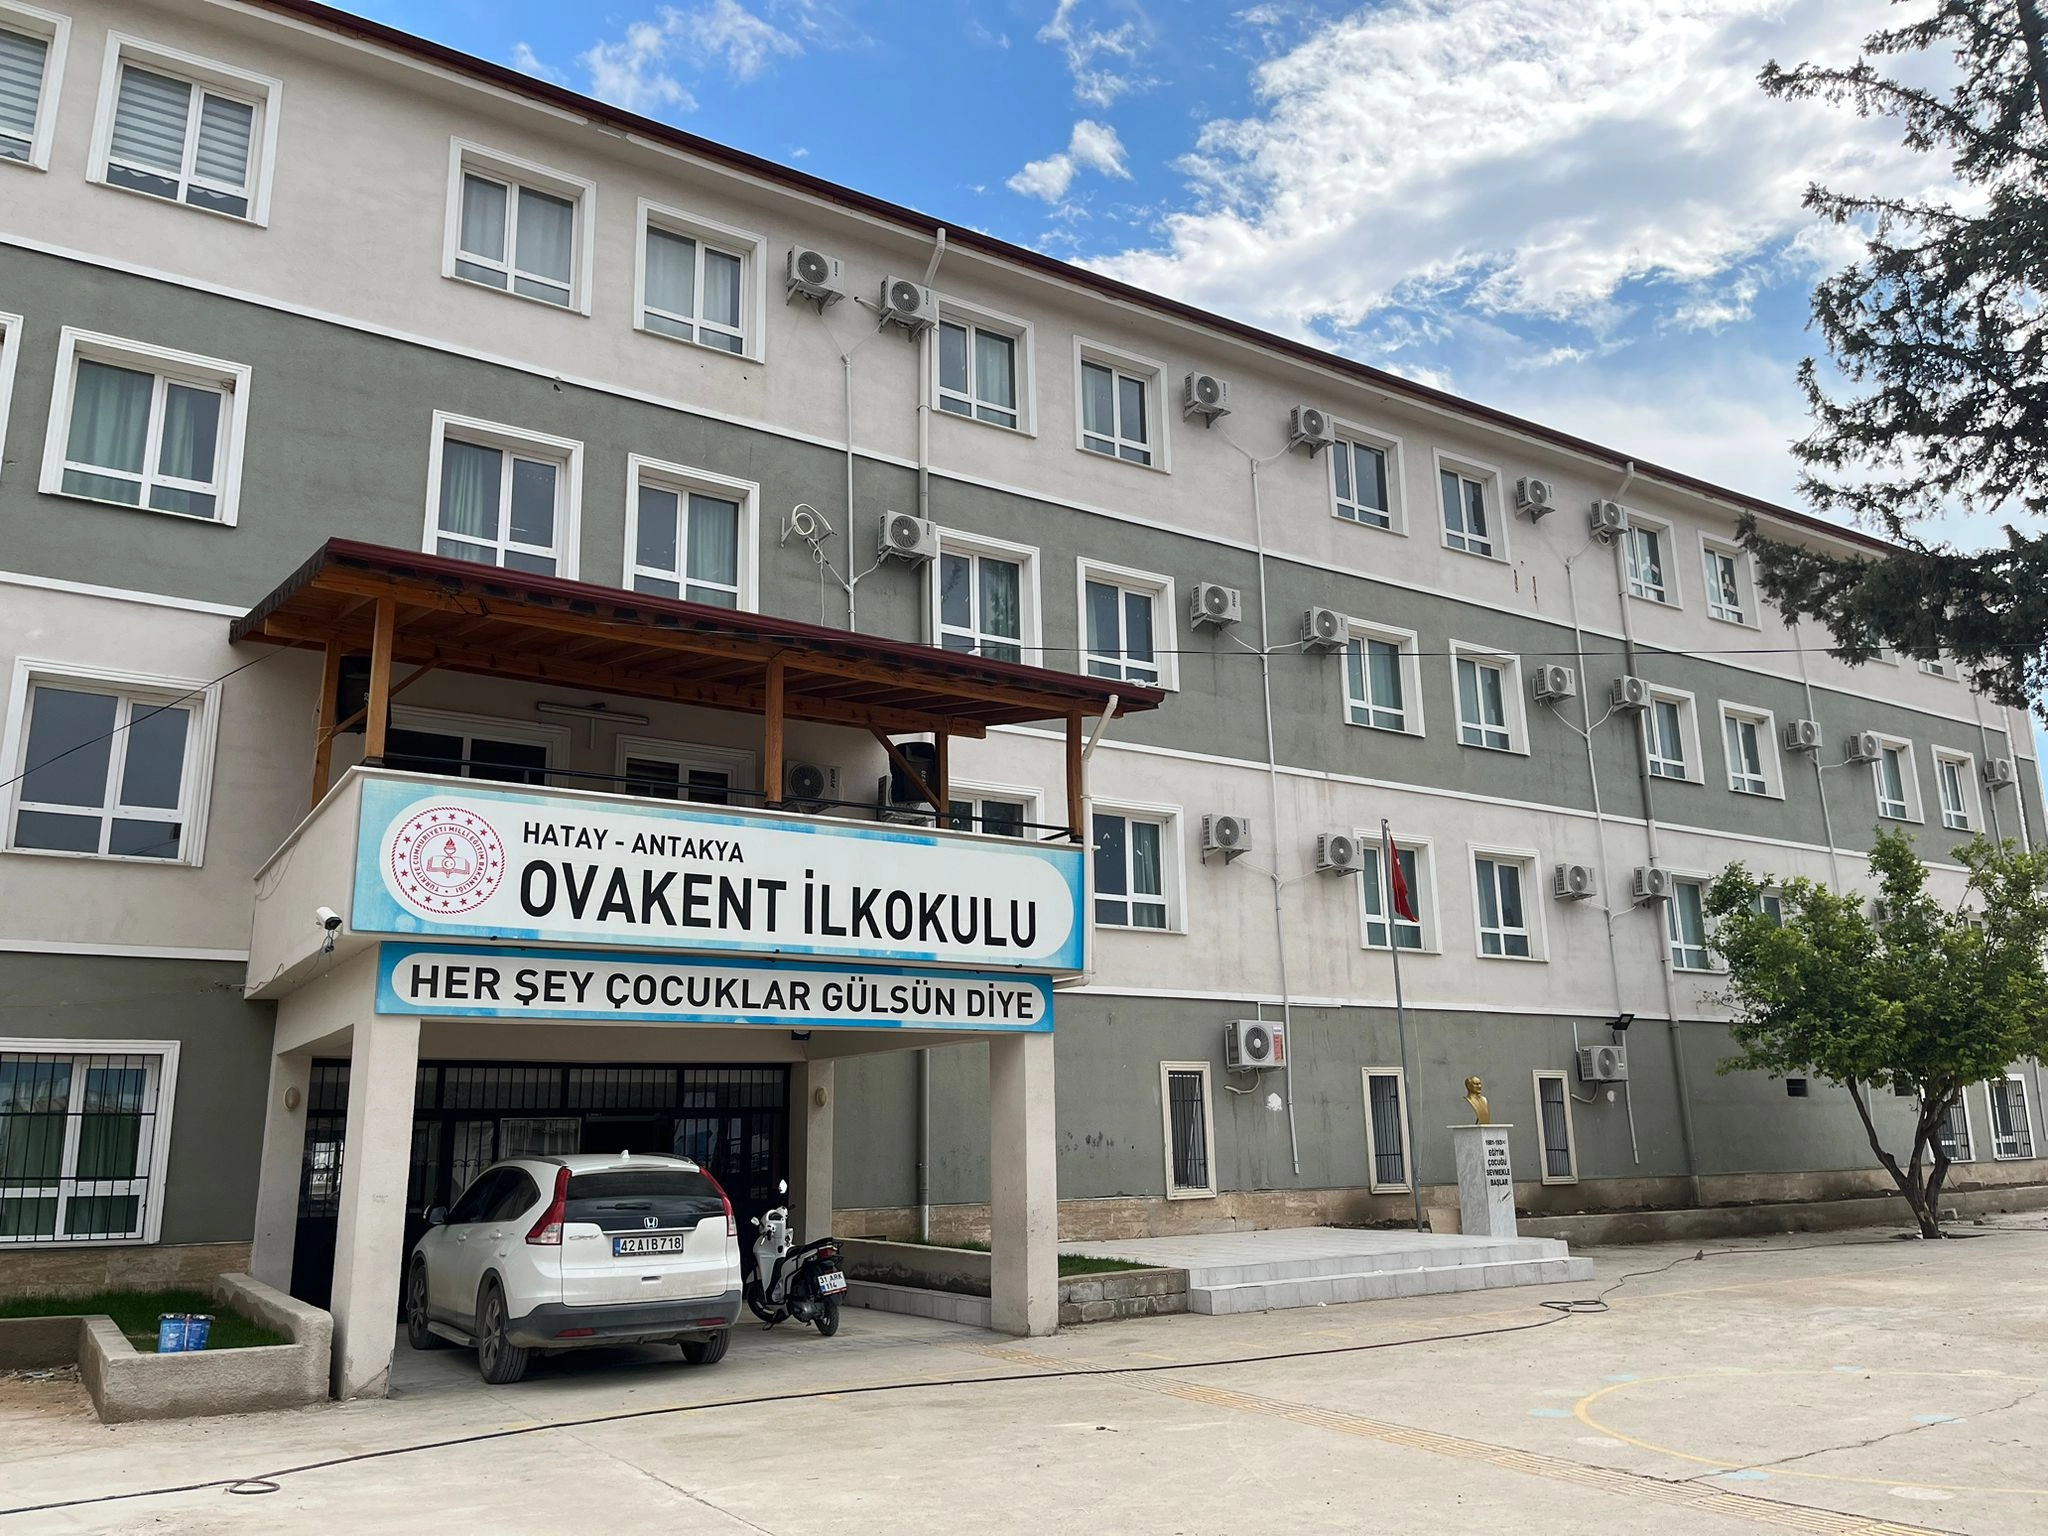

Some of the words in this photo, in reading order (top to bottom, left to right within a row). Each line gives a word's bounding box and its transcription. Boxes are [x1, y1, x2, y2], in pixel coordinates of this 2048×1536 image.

[523, 821, 609, 850] HATAY
[631, 832, 744, 863] ANTAKYA
[520, 859, 787, 933] OVAKENT
[804, 868, 1036, 949] İLKOKULU
[410, 964, 501, 1001] HER
[513, 968, 595, 1006] ŞEY
[606, 972, 811, 1011] ÇOCUKLAR
[822, 975, 955, 1016] GÜLSÜN
[967, 982, 1034, 1019] DİYE
